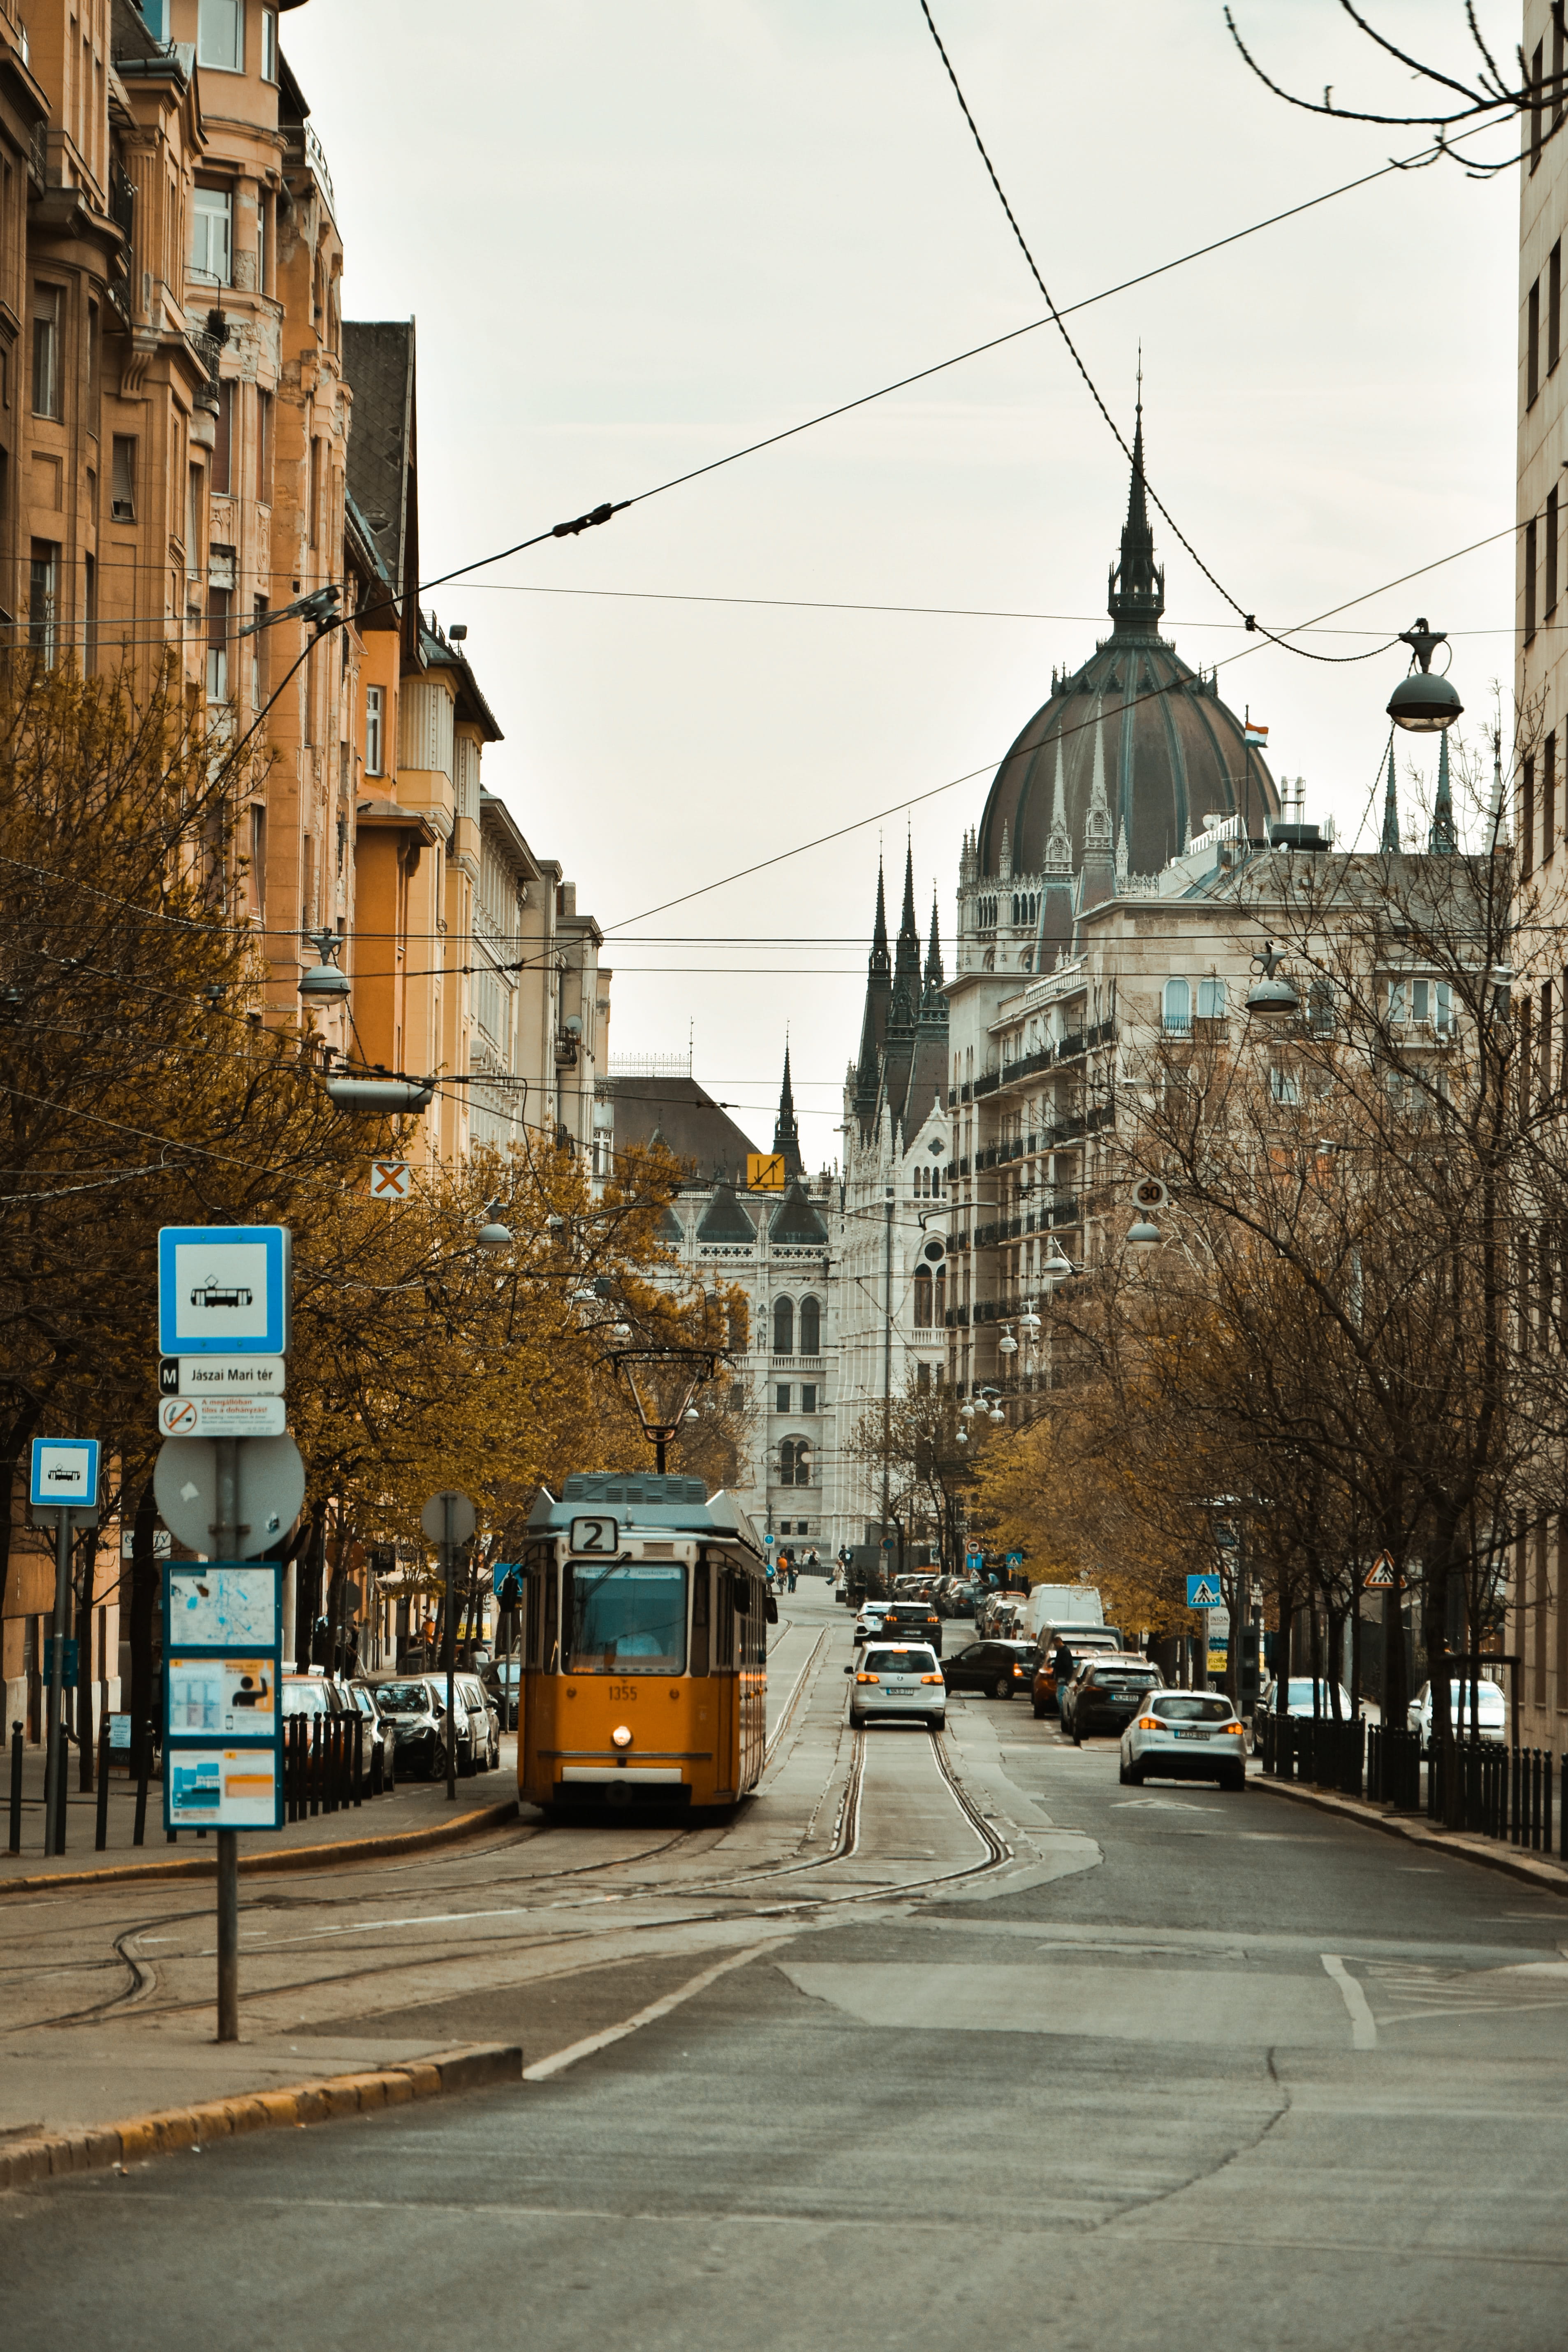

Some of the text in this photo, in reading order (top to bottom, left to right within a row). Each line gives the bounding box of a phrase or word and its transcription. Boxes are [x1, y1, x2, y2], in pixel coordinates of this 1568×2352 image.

[1141, 1186, 1160, 1200] 30
[163, 1369, 176, 1384] M
[192, 1367, 273, 1381] Jászai Mari tér
[584, 1522, 602, 1550] 2
[623, 1569, 630, 1578] 2
[609, 1686, 637, 1701] 1355
